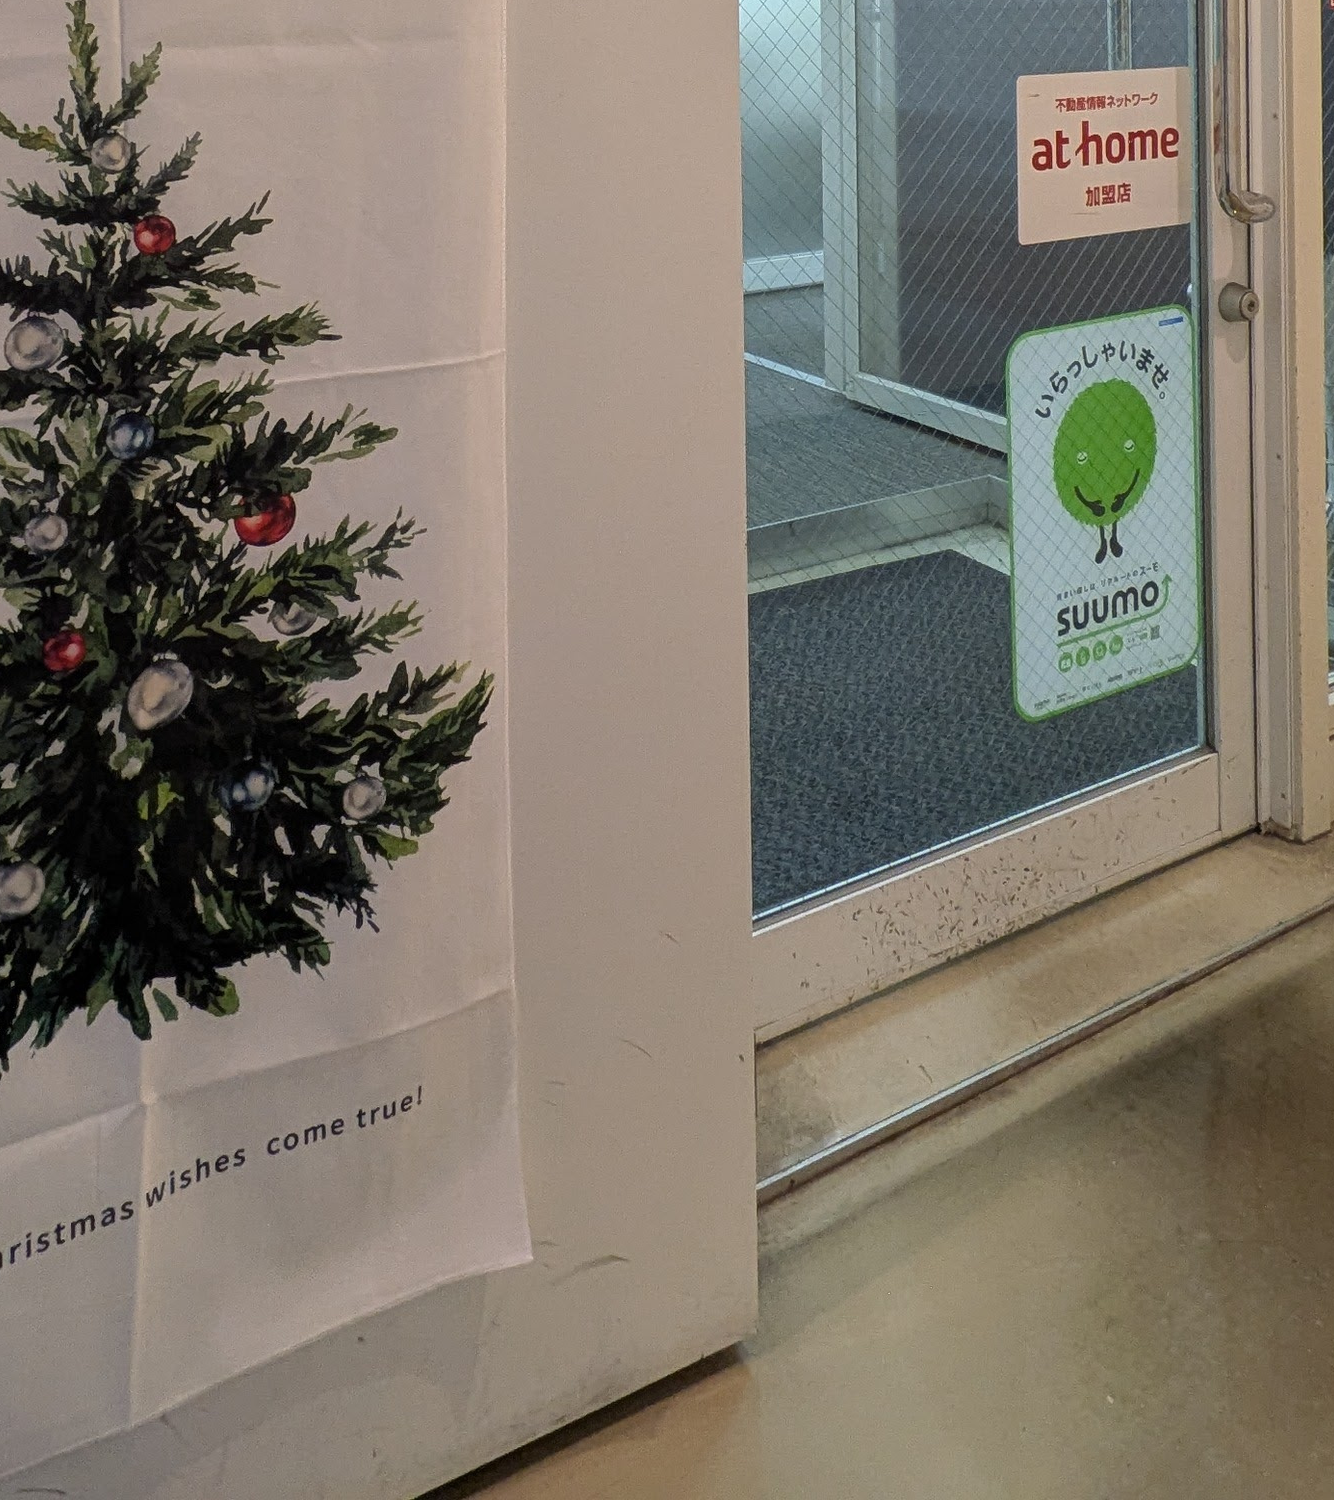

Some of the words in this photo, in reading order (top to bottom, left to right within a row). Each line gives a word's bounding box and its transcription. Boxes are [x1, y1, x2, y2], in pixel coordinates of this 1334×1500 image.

[1055, 92, 1159, 113] 不動産情報ネットワーク
[1031, 129, 1072, 172] at
[1074, 120, 1180, 167] home
[1085, 182, 1132, 207] 加盟店
[1034, 340, 1170, 419] いらっしゃいませ。
[143, 1144, 247, 1209] wishes
[265, 1112, 346, 1156] come
[355, 1085, 424, 1131] true!
